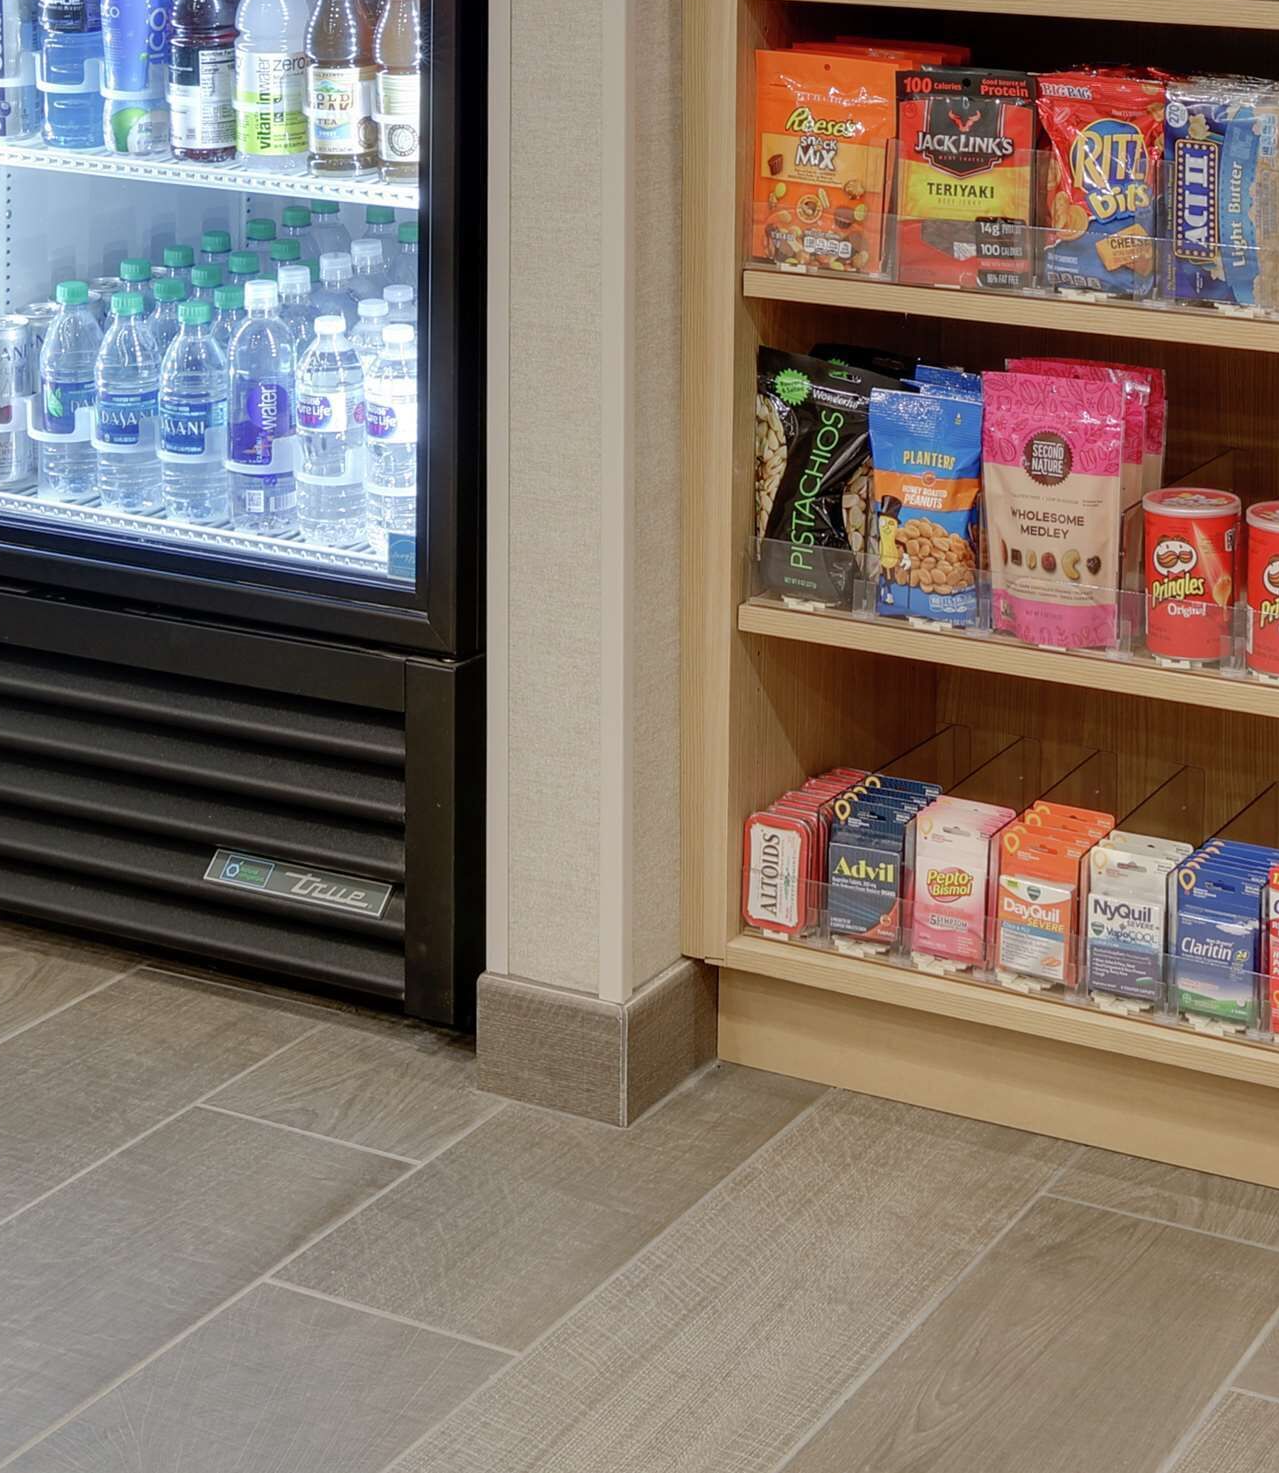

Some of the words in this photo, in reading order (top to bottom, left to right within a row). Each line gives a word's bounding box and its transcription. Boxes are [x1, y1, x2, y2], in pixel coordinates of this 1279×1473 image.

[273, 56, 306, 71] zero
[904, 78, 932, 93] 100
[934, 83, 962, 91] Calories
[980, 85, 1029, 97] Protein
[786, 107, 864, 137] Reese's
[915, 131, 957, 154] JACK
[958, 134, 1014, 155] LINK'S
[1074, 128, 1146, 190] RITZ
[1184, 153, 1208, 187] II
[927, 181, 995, 199] TERIYAKI
[1228, 161, 1243, 214] Butter
[1089, 183, 1151, 220] bits
[980, 222, 1000, 236] 14g
[1184, 190, 1208, 248] ACT
[980, 243, 1001, 256] 100
[1230, 220, 1246, 268] Light
[903, 450, 956, 470] PLANTERS
[1032, 442, 1064, 461] SECOND
[1031, 458, 1063, 476] NATURE
[791, 410, 844, 570] PISTACHIOS
[904, 495, 943, 509] PEANUTS
[1011, 507, 1085, 527] WHOLESOME
[1021, 526, 1069, 540] MEDLEY
[1152, 573, 1205, 608] Pringles
[761, 832, 781, 917] ALTOIDS
[832, 856, 895, 883] Advil
[927, 869, 973, 886] Pepto-
[932, 883, 973, 897] Bismol
[1003, 897, 1061, 924] DayQuil
[1093, 898, 1152, 924] NyQuil
[1027, 918, 1064, 933] SEVERE
[1181, 936, 1232, 961] Claritin
